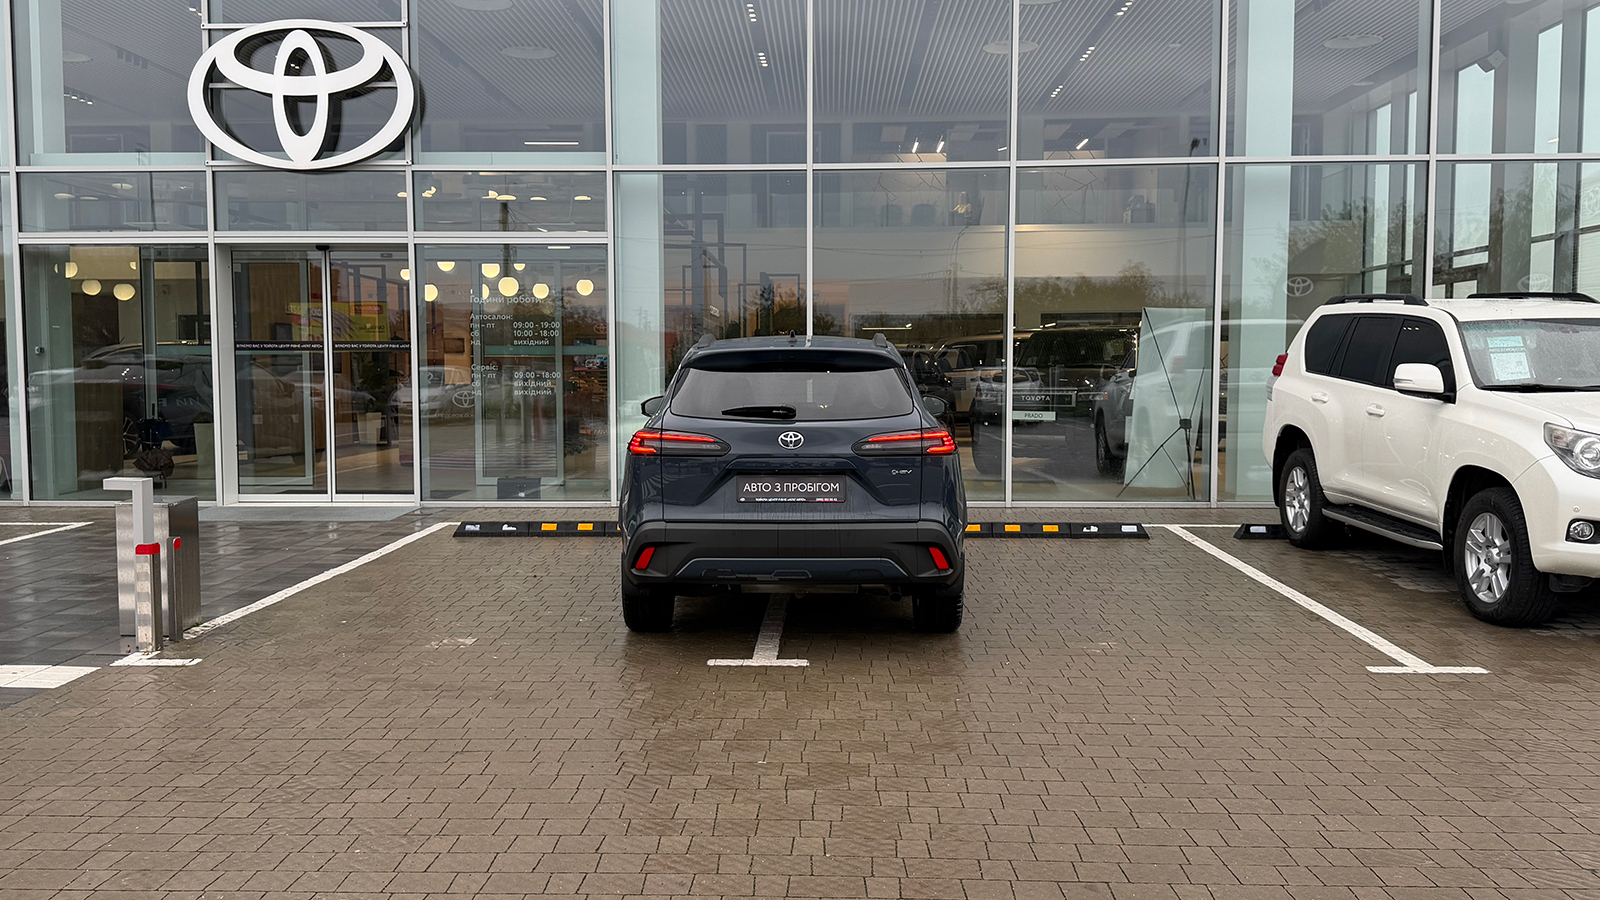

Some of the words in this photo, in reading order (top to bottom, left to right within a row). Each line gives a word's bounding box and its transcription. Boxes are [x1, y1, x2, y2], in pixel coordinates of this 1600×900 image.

[470, 295, 504, 304] Години
[513, 321, 534, 329] 09:00
[541, 321, 560, 329] 19:00
[471, 363, 498, 371] Сервіс:
[514, 388, 552, 396] вихідний
[743, 482, 772, 492] АВТО
[774, 482, 781, 492] З
[783, 482, 840, 492] ПРОБІГОМ
